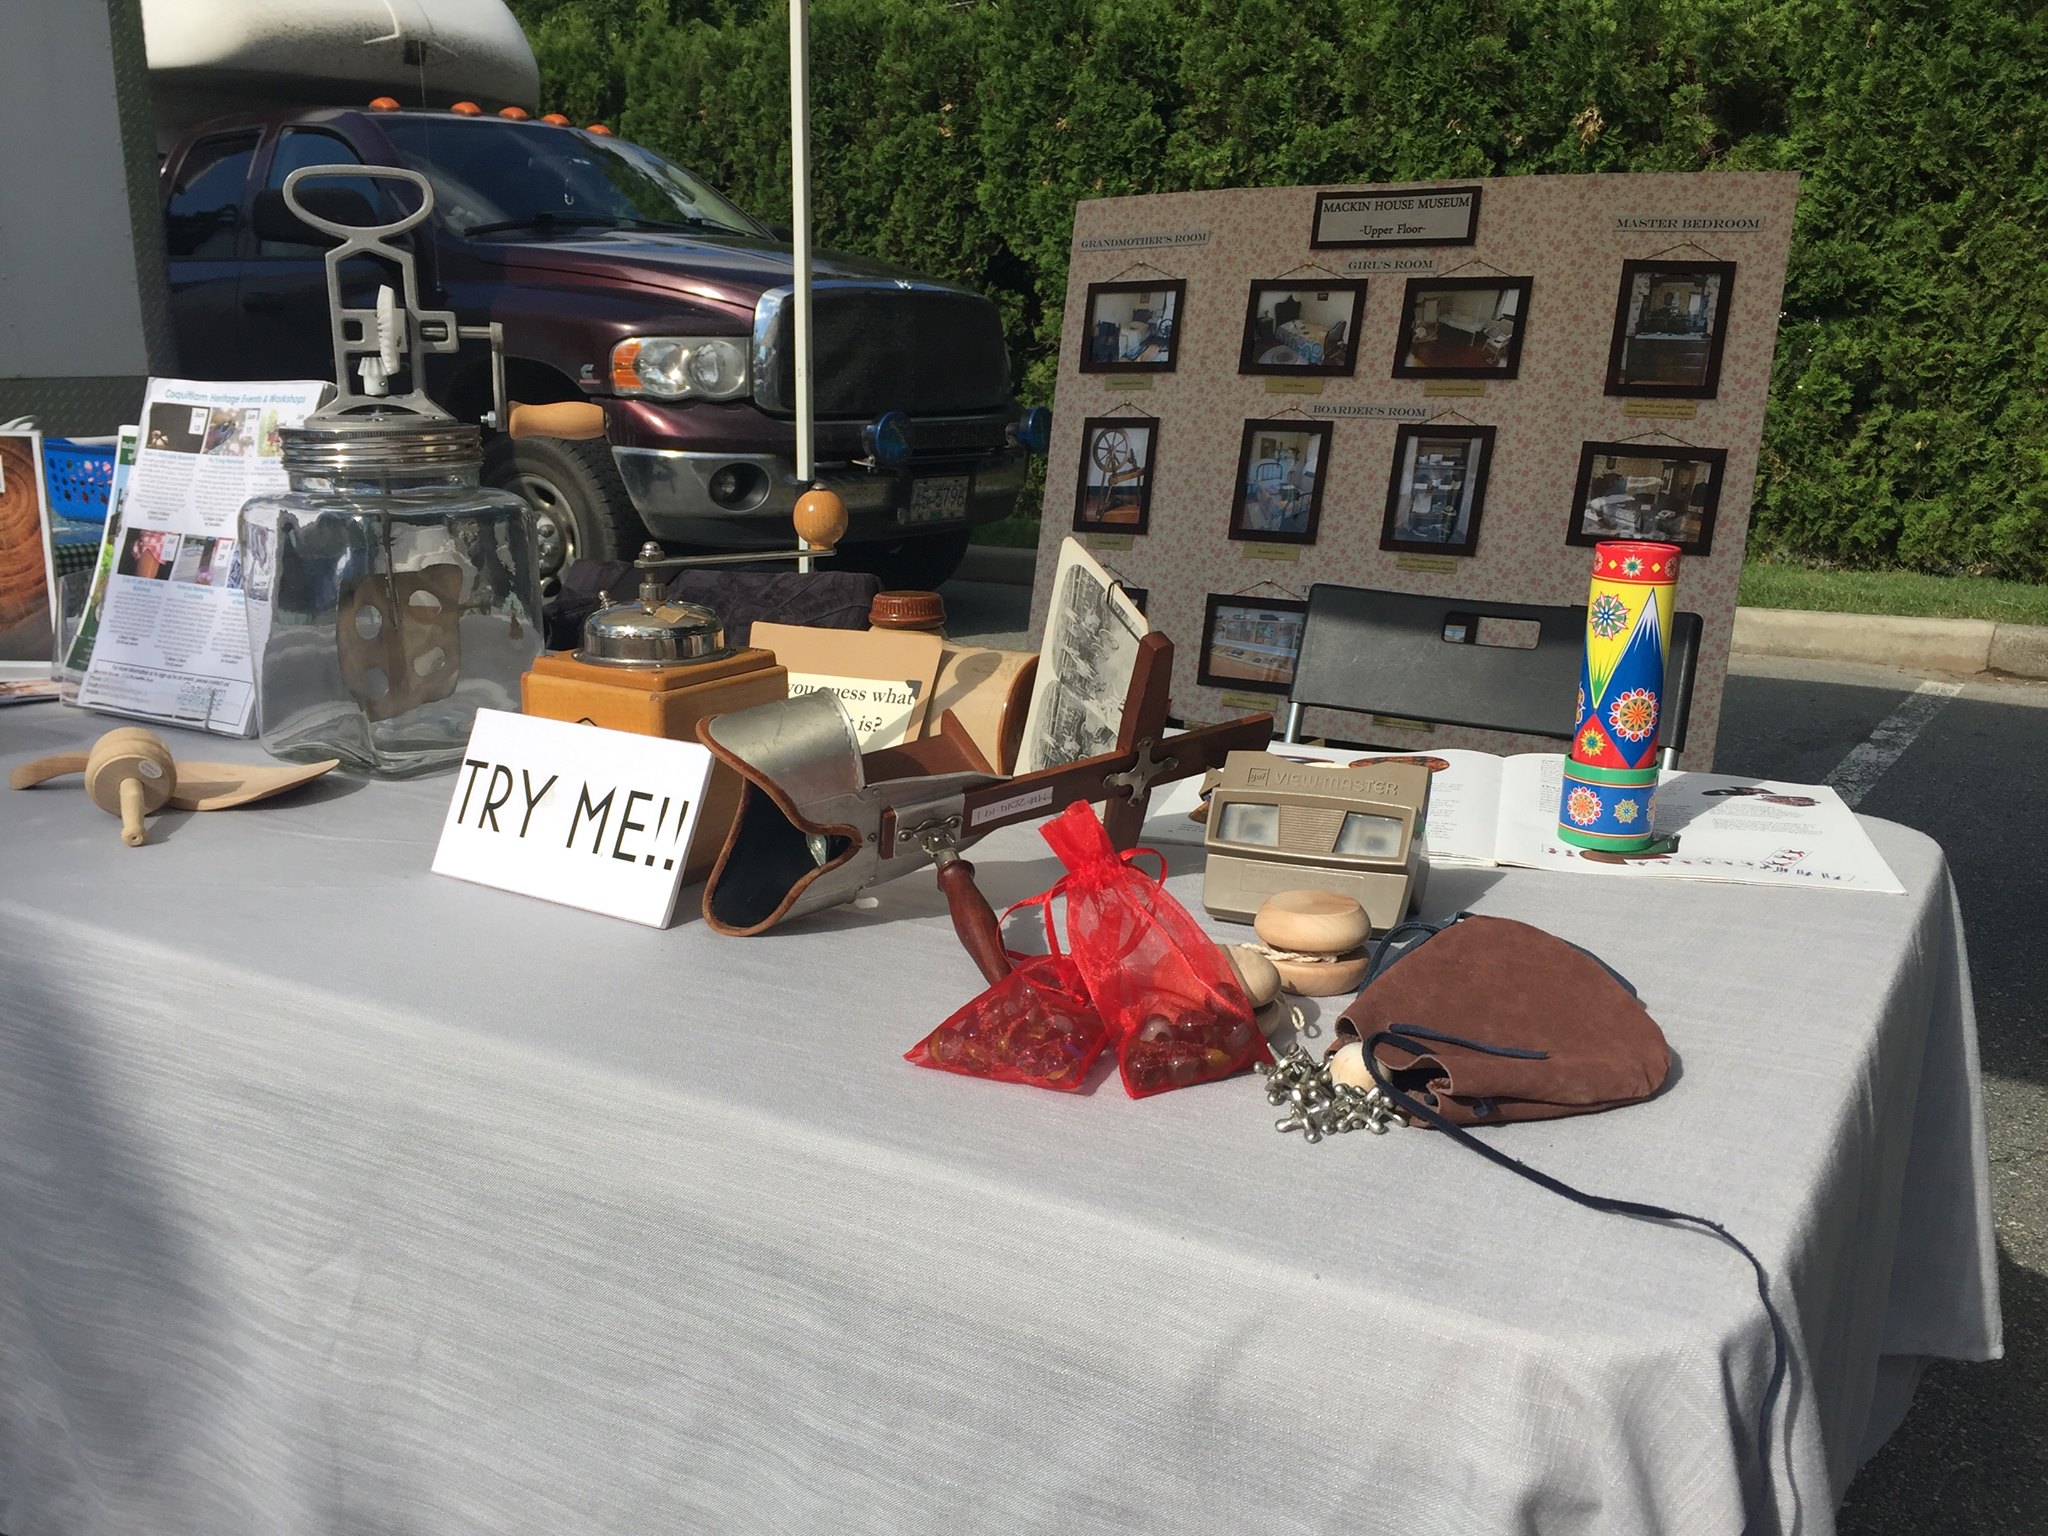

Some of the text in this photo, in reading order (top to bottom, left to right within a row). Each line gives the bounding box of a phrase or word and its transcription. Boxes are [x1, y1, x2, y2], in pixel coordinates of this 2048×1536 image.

[1323, 196, 1470, 213] MACKIN HOUSE MUSEUM
[1359, 223, 1426, 238] -Upper Floor-
[1617, 218, 1760, 229] MASTER BEDROOM
[1081, 232, 1207, 249] GRANDMOTHER'S ROOM
[1348, 259, 1433, 270] GIRL'S ROOM
[1312, 404, 1427, 417] BOARDER'S ROOM
[831, 687, 867, 701] uess
[872, 687, 915, 706] what
[857, 715, 883, 732] is?
[457, 758, 690, 871] TRY ME!!
